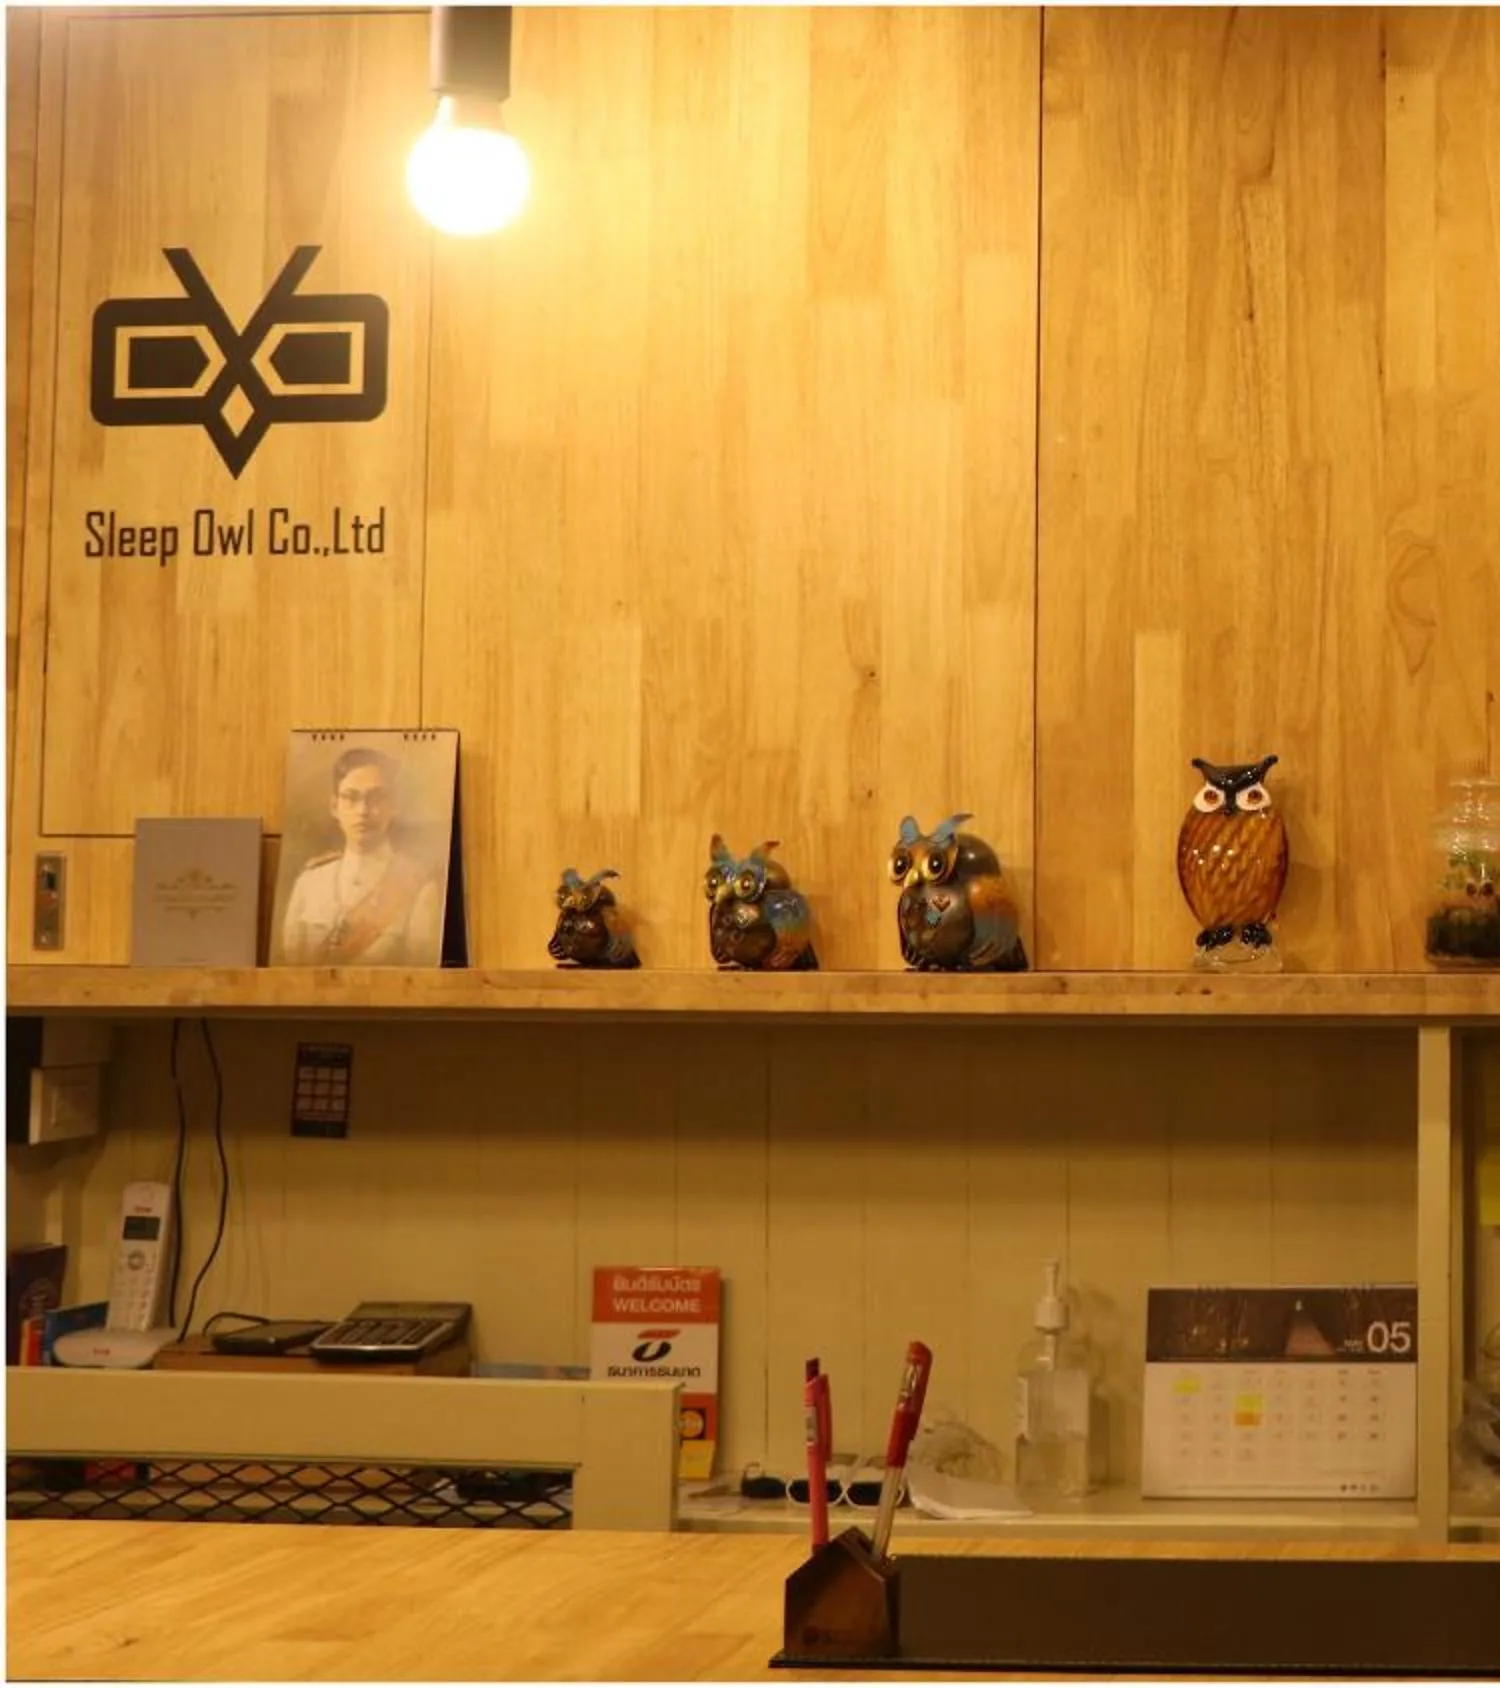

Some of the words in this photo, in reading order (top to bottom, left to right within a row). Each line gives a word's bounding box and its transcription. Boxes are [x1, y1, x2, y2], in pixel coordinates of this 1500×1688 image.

[85, 510, 179, 567] Sleep
[193, 509, 254, 557] Owl
[268, 507, 386, 557] Co.,Ltd
[611, 1297, 702, 1313] WELCOME
[1367, 1320, 1411, 1353] 05
